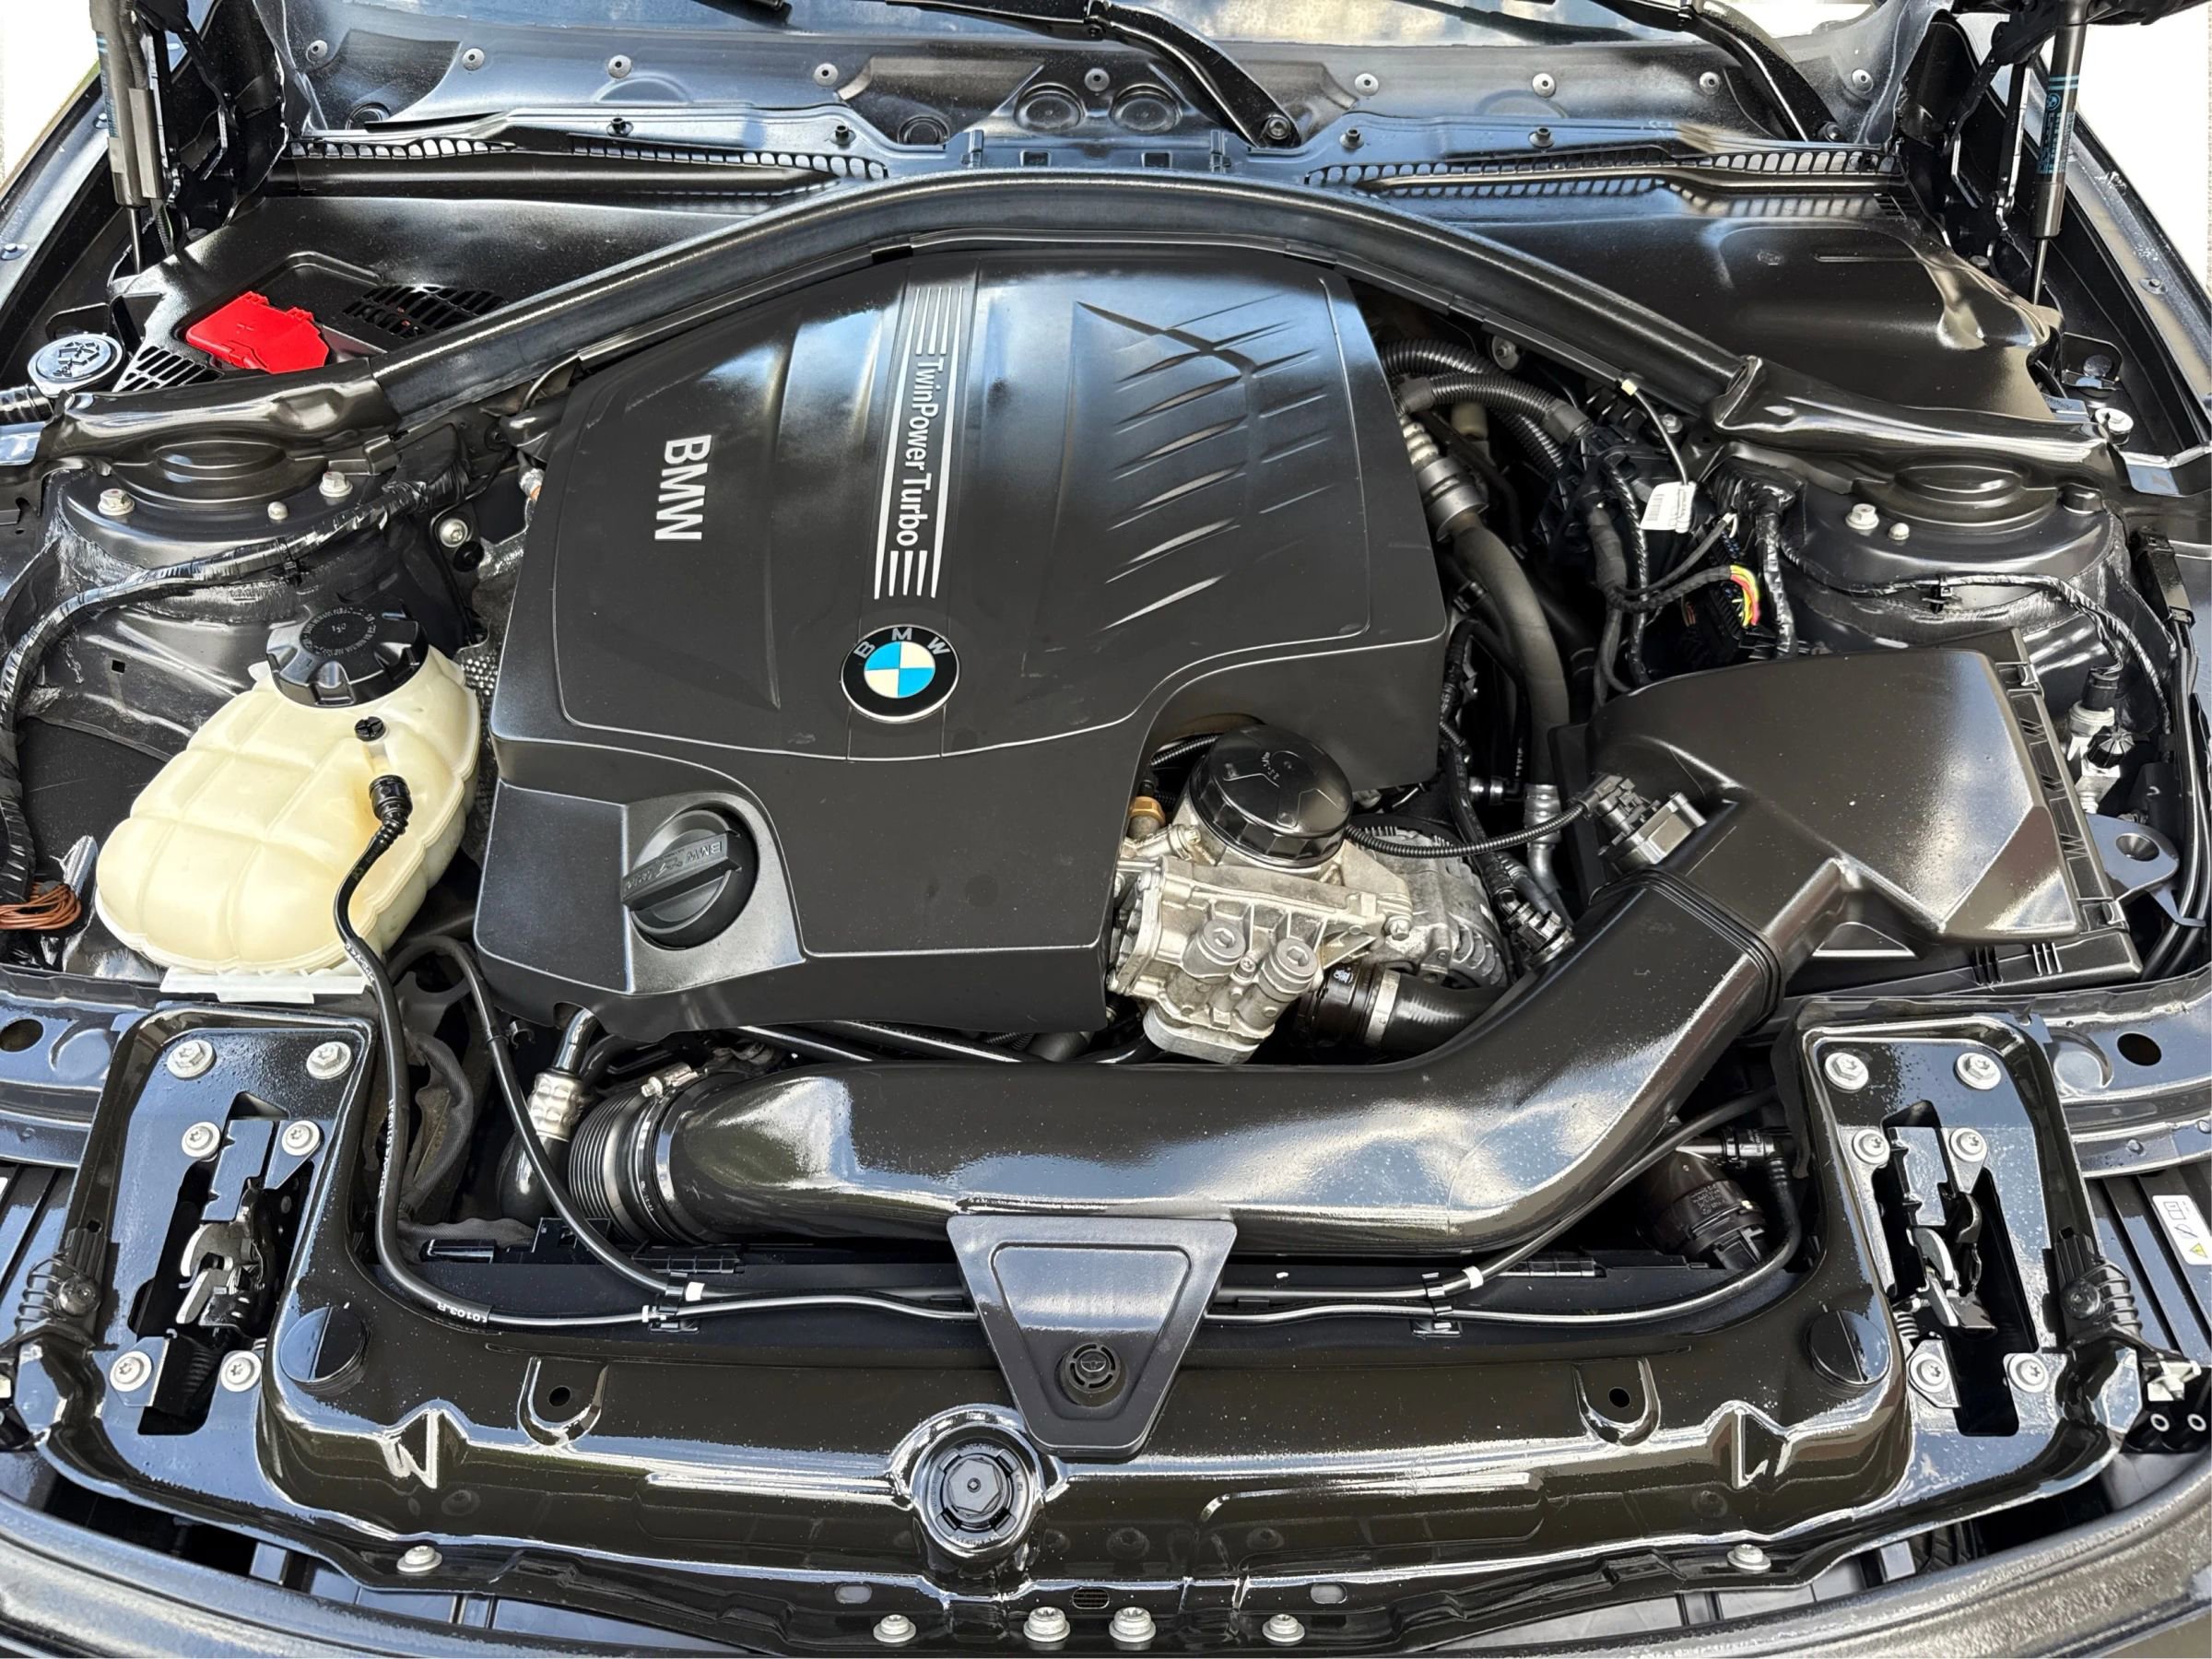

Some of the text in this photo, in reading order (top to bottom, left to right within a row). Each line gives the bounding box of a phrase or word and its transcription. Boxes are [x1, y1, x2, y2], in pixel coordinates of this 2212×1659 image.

[896, 356, 945, 547] TwinPower Turbo
[653, 434, 712, 540] BMW
[853, 627, 951, 659] BMW
[685, 841, 723, 865] BMW
